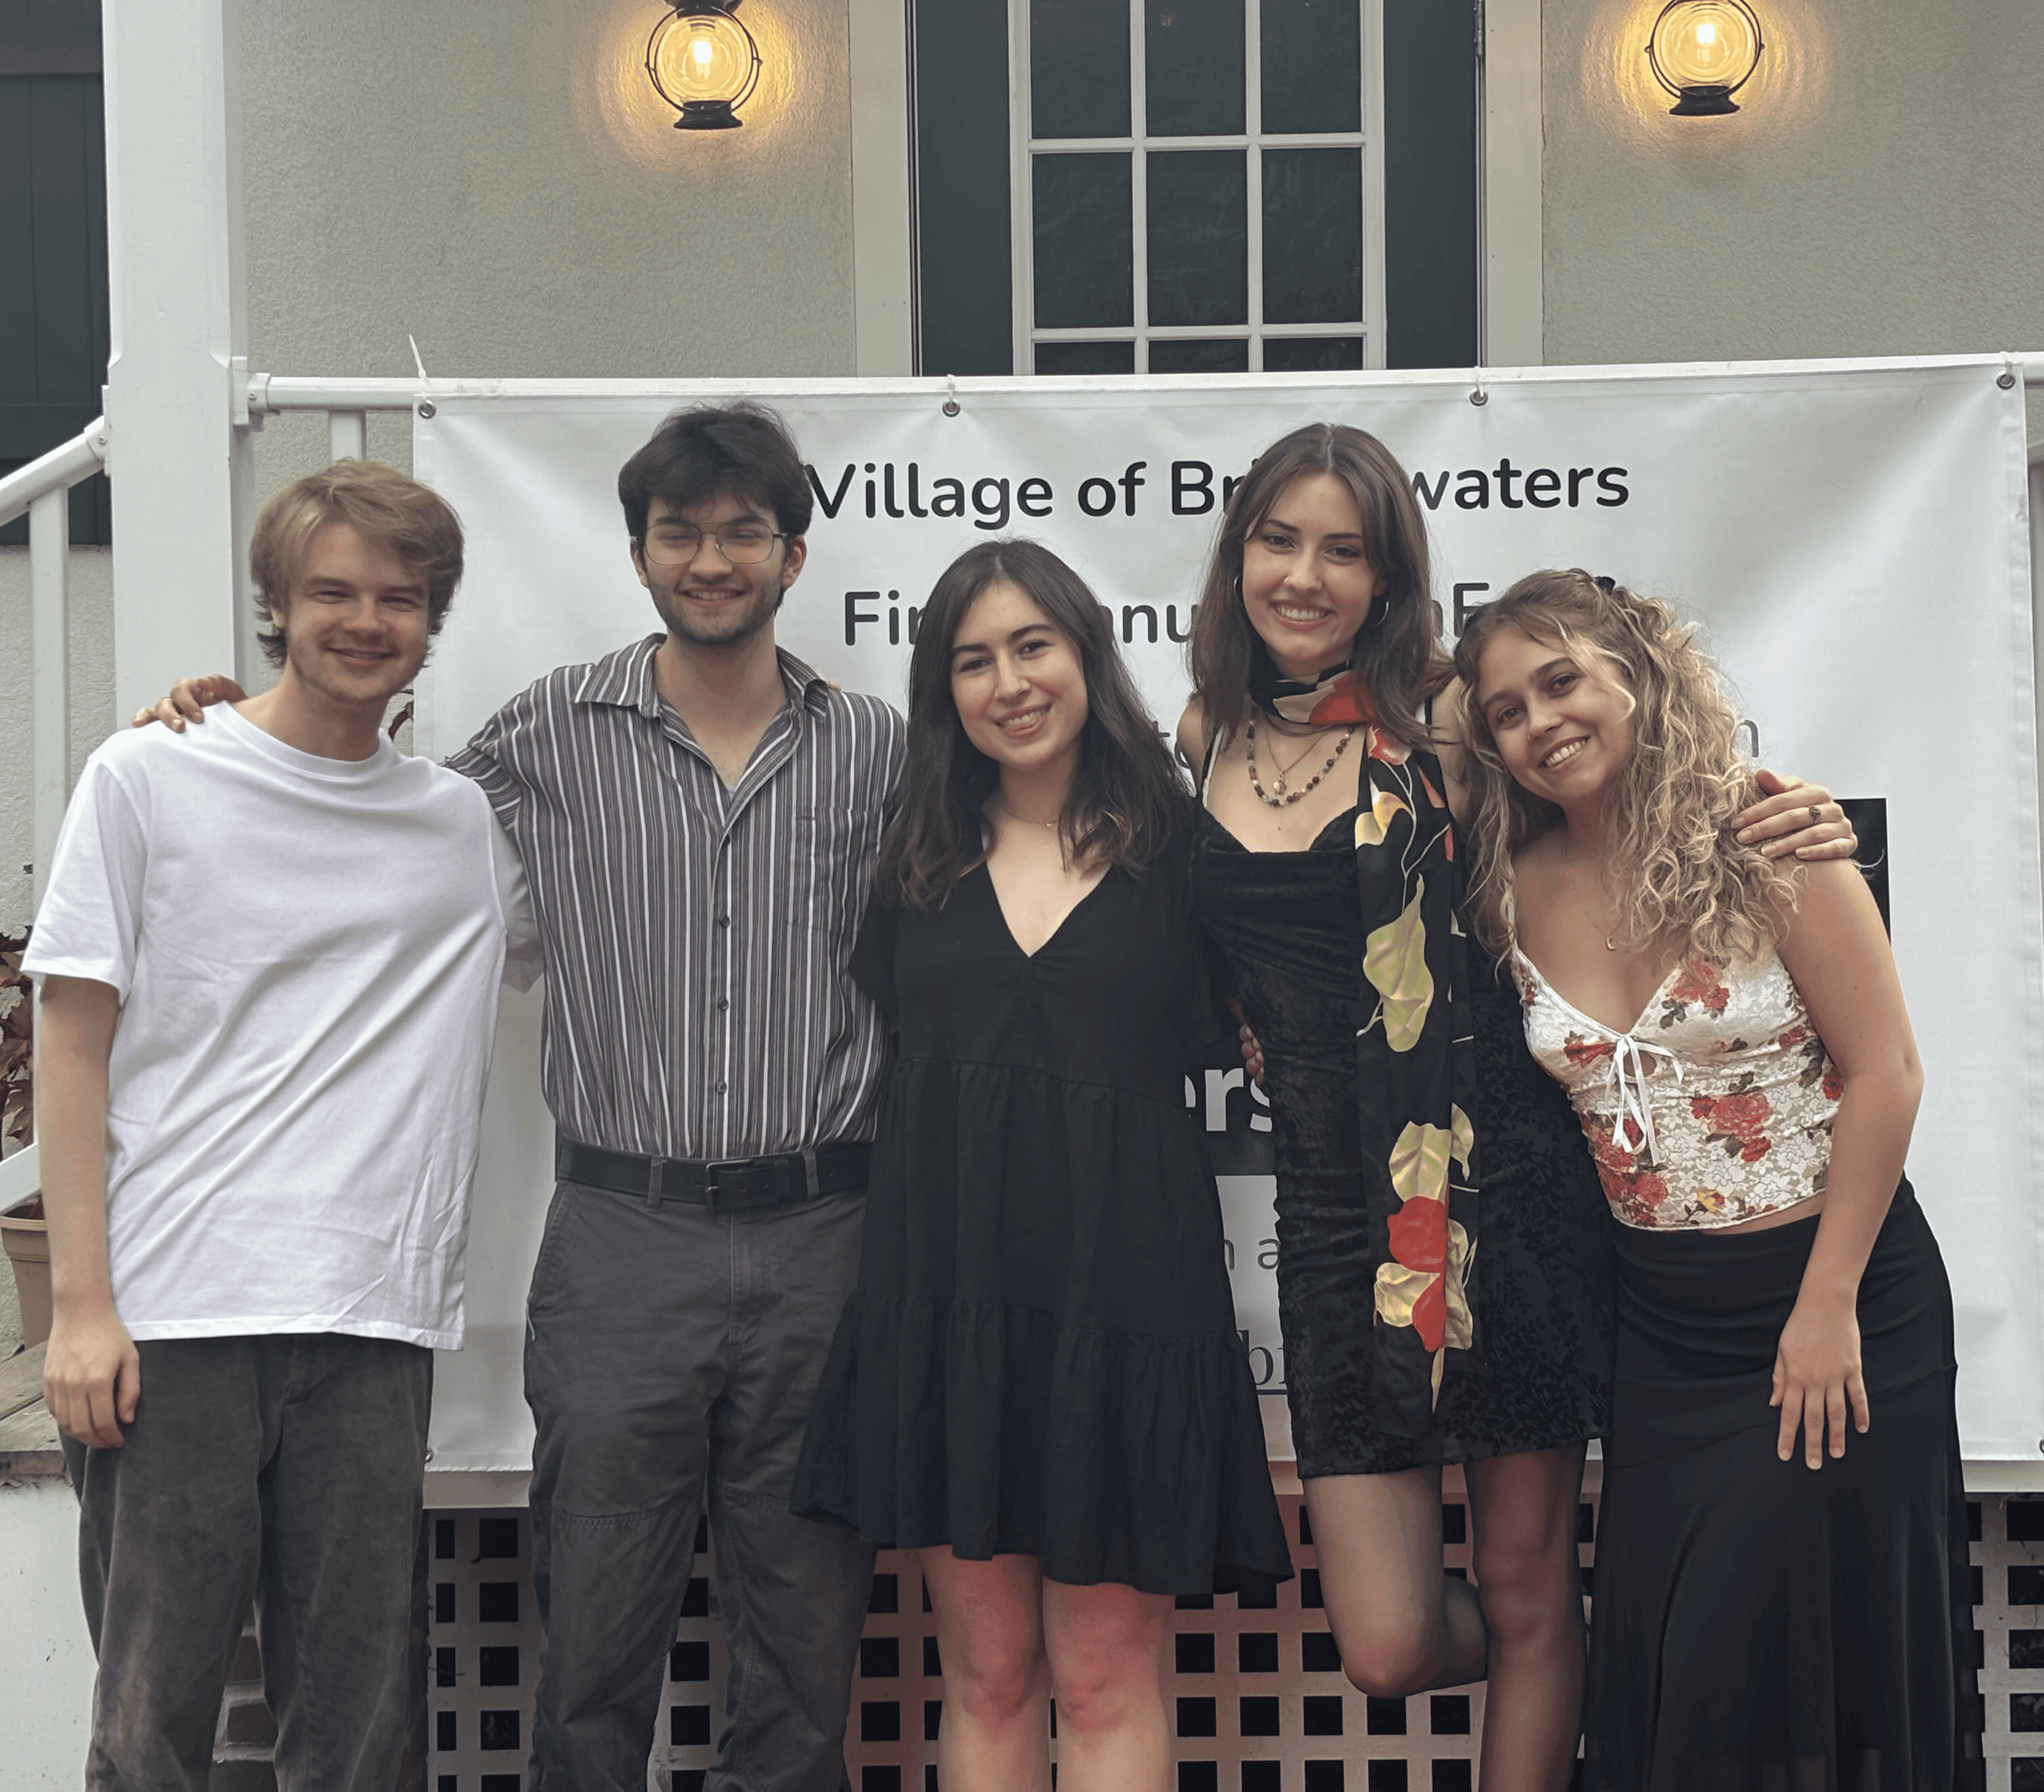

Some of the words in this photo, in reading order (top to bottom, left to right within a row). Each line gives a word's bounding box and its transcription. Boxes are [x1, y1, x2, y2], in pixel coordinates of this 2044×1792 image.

[804, 463, 1053, 530] Village
[1078, 461, 1148, 517] of
[1171, 457, 1629, 516] Brwaters
[845, 590, 926, 646] Fir
